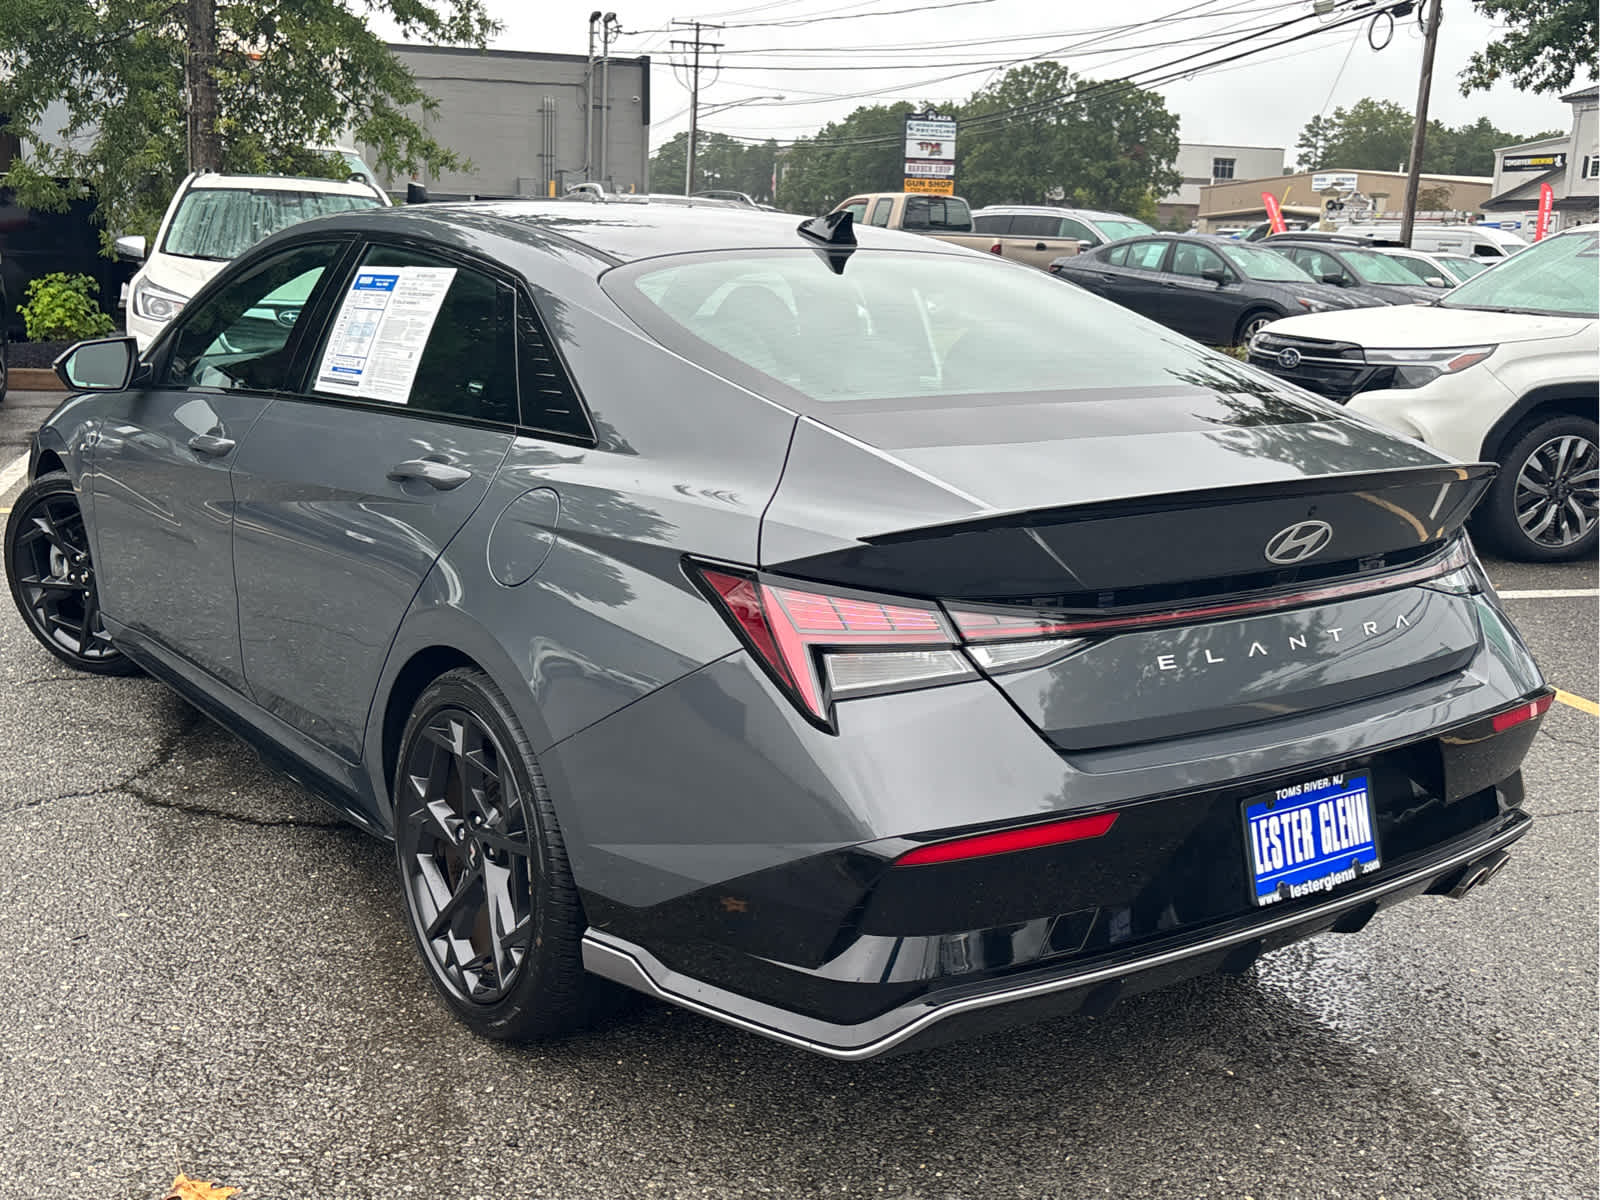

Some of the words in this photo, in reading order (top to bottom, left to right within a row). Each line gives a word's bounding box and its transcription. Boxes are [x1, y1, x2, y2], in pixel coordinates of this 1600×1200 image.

[1157, 614, 1410, 670] ELANTRA
[1276, 785, 1302, 800] TOMS
[1333, 774, 1344, 785] NJ
[1251, 808, 1315, 875] LESTER
[1318, 792, 1371, 855] GLENN
